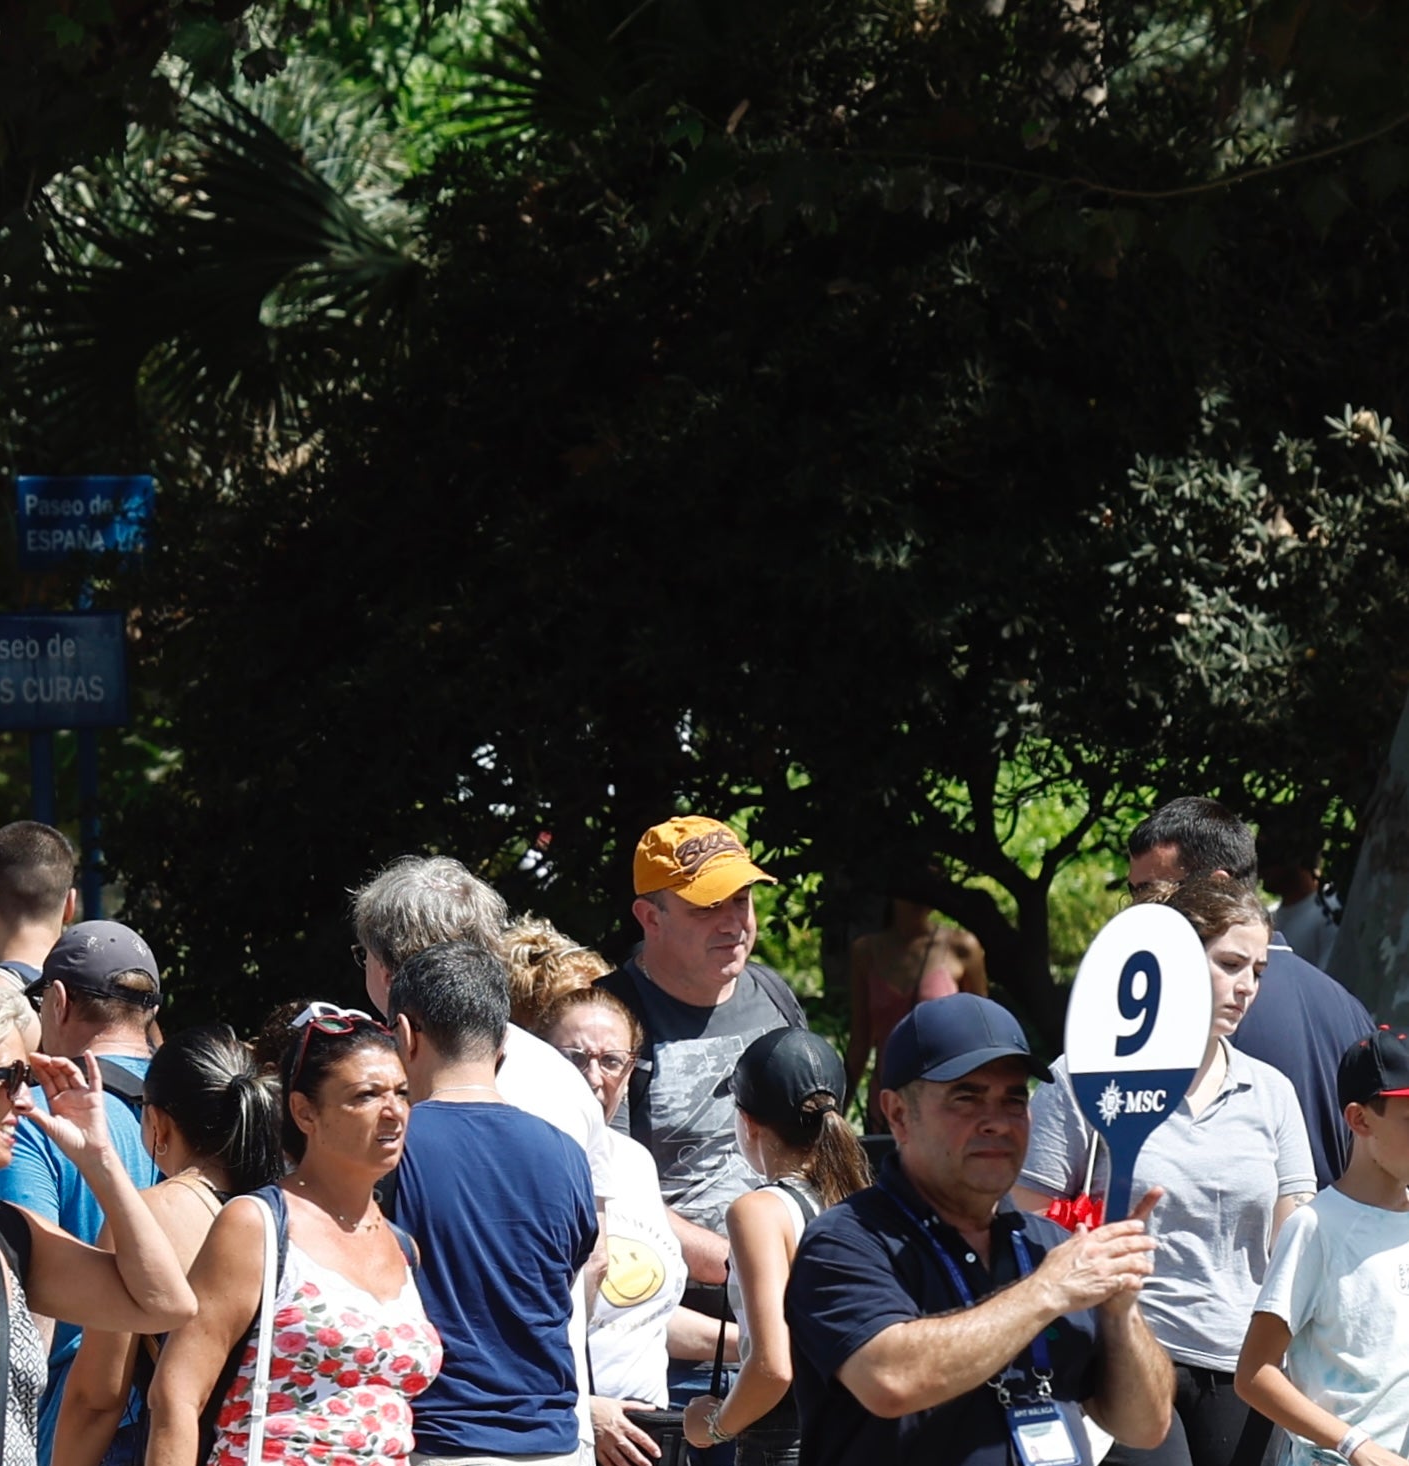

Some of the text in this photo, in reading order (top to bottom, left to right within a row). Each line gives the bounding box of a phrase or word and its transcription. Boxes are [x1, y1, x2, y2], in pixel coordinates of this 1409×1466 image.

[25, 494, 84, 517] Paseo
[27, 524, 105, 552] ESPAÑA
[47, 633, 76, 658] de
[22, 676, 104, 703] CURAS
[1114, 950, 1162, 1057] 9
[1124, 1089, 1167, 1114] MSC
